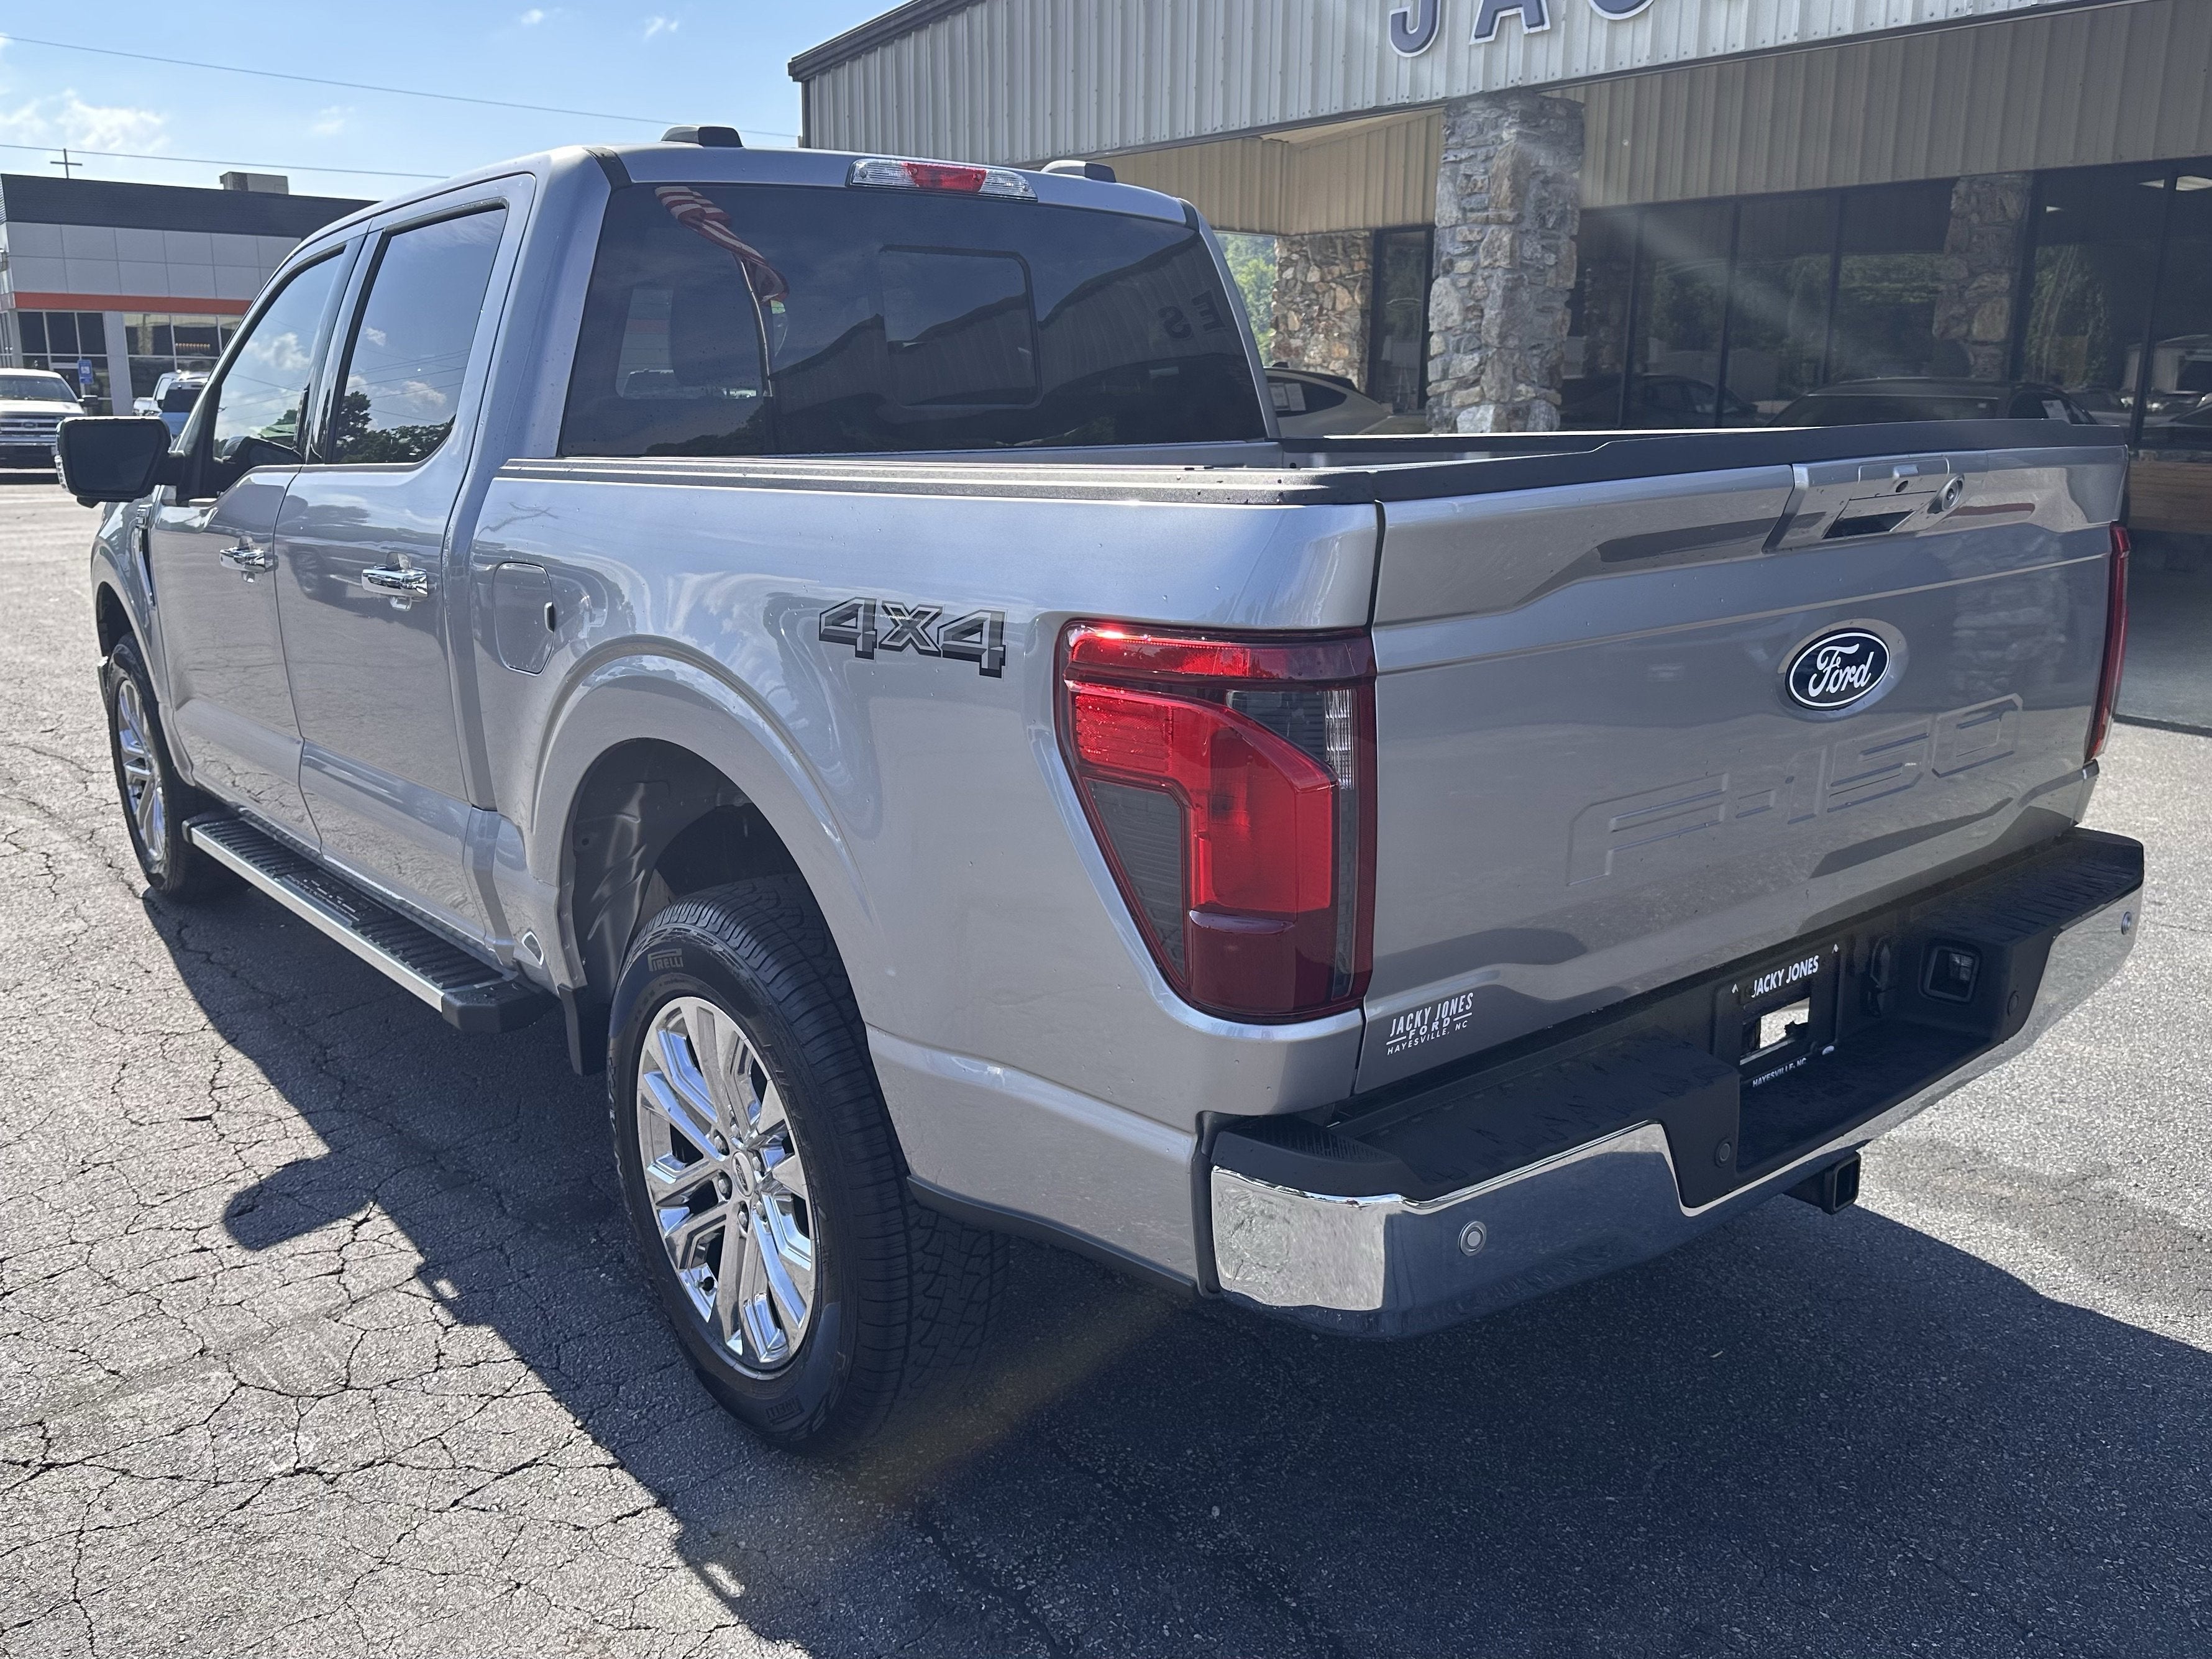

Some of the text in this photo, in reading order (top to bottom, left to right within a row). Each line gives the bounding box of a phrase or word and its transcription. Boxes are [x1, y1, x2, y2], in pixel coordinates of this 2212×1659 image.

[1808, 643, 1875, 697] Ford
[1566, 692, 2023, 887] F-150
[647, 948, 683, 972] PIRELLI
[1751, 955, 1819, 998] JACKY JONES
[1389, 992, 1474, 1038] JACKY JONES
[1408, 1017, 1451, 1040] FORD
[1387, 1020, 1468, 1056] HAYESVILLE, NC
